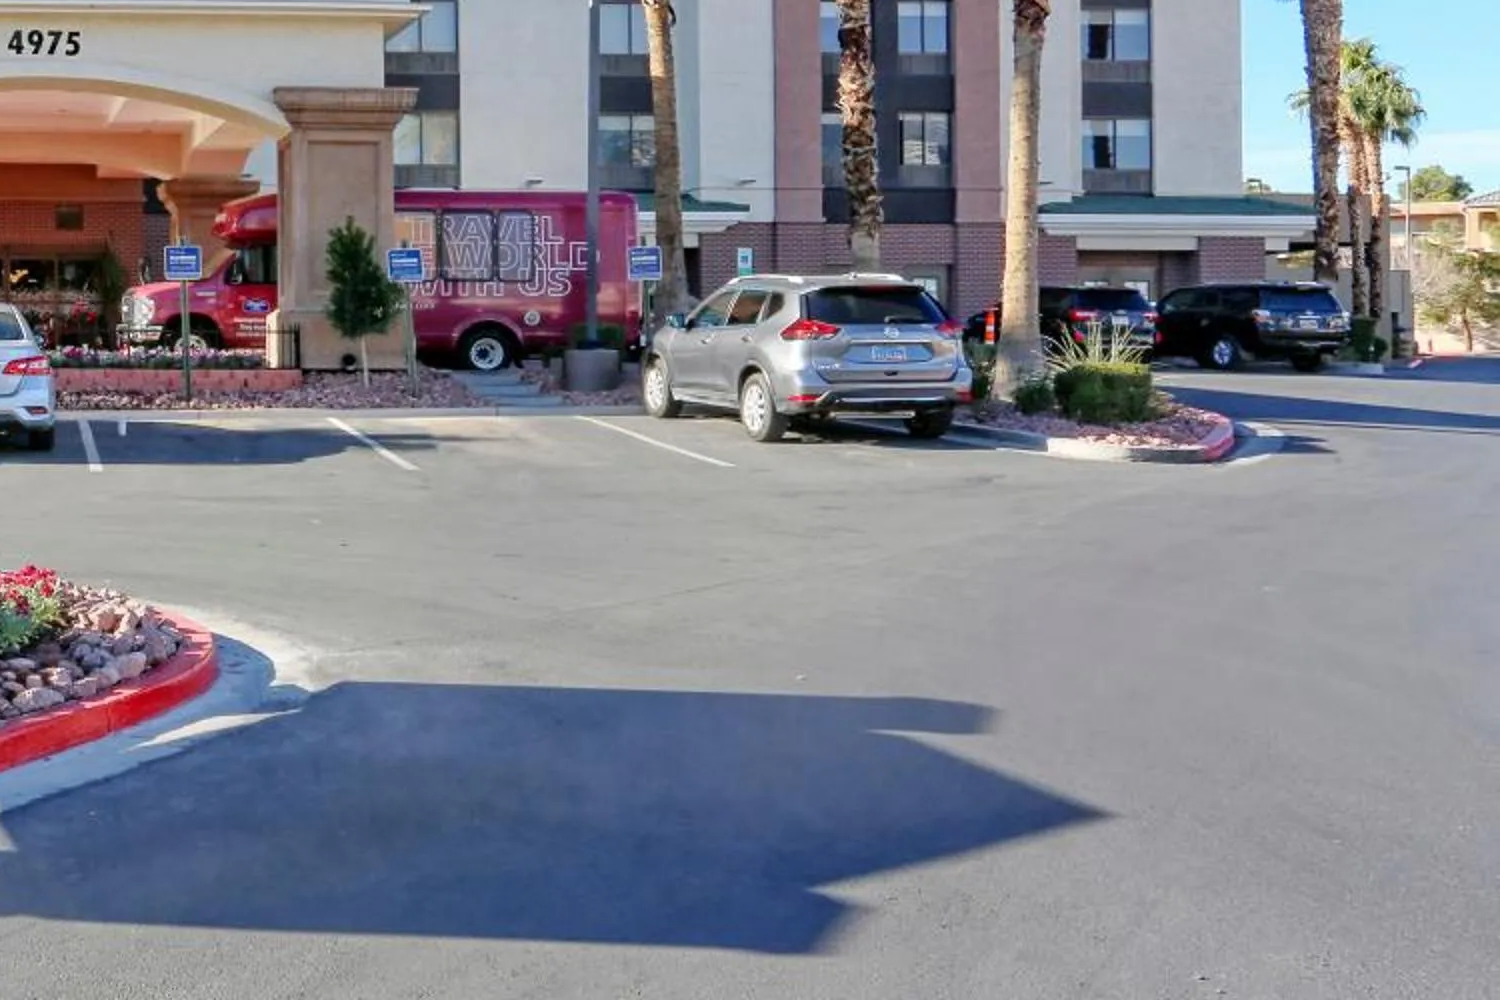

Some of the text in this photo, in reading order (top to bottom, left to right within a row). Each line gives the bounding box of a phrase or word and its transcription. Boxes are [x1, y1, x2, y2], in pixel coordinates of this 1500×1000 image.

[7, 29, 81, 56] 4975
[404, 215, 565, 244] TRAVEL
[517, 267, 572, 297] US
